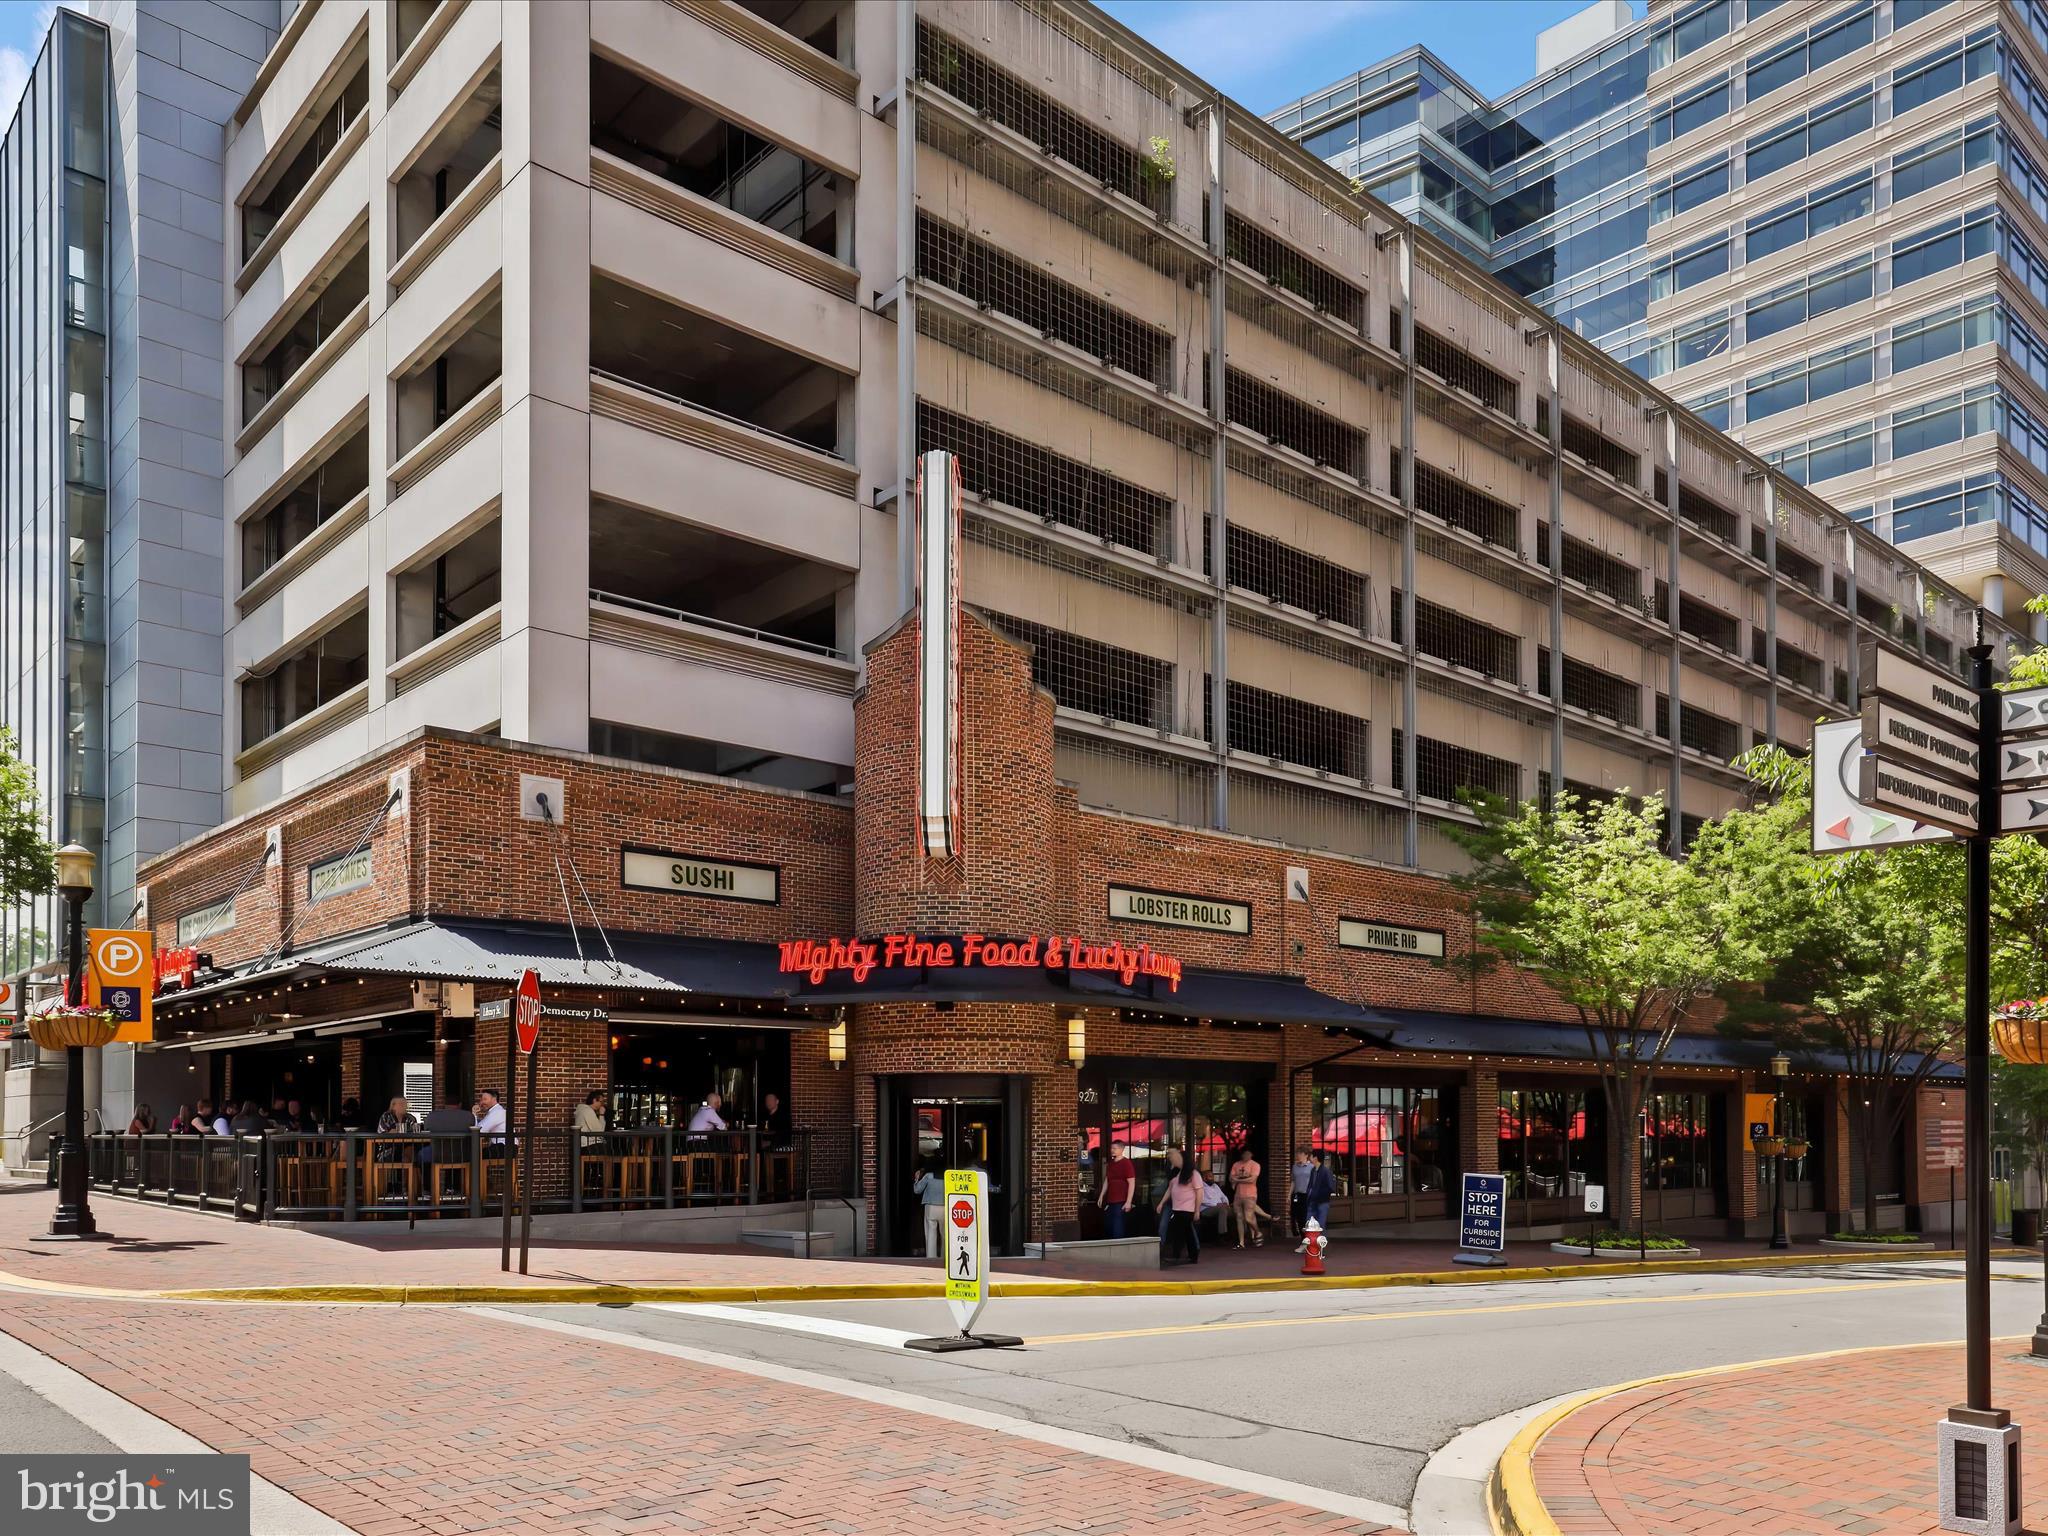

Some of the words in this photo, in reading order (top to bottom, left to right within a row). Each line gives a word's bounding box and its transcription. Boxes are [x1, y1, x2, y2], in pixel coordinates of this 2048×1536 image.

[1932, 684, 1971, 716] PAVILION
[1888, 718, 1930, 749] MERCURY
[1929, 735, 1971, 766] FOUNTAIN
[1878, 771, 1938, 807] INFORMATION
[1938, 793, 1970, 817] CENTER
[671, 863, 735, 891] SUSHI
[1129, 895, 1189, 921] LOBSTER
[1192, 904, 1232, 926] ROLLS
[1367, 928, 1399, 947] PRIME
[1401, 933, 1418, 949] RIB
[110, 944, 134, 969] P
[779, 936, 878, 985] Mighty
[884, 933, 955, 968] Fine
[963, 934, 1040, 967] Food
[1044, 935, 1065, 969] &
[1068, 936, 1140, 986] Lucky
[519, 993, 539, 1028] STOP
[539, 1004, 591, 1020] Democracy
[593, 1008, 609, 1019] Dr.
[1078, 1091, 1095, 1102] 927
[950, 1173, 972, 1183] STATE
[954, 1183, 969, 1192] LAW
[1468, 1192, 1498, 1204] STOP
[952, 1208, 973, 1220] STOP
[1467, 1204, 1497, 1216] HERE
[1474, 1219, 1490, 1227] FOR
[1463, 1227, 1500, 1238] CURBSIDE
[957, 1235, 969, 1243] FOR
[1468, 1237, 1496, 1247] PICKUP
[949, 1289, 976, 1298] CROSSWALK
